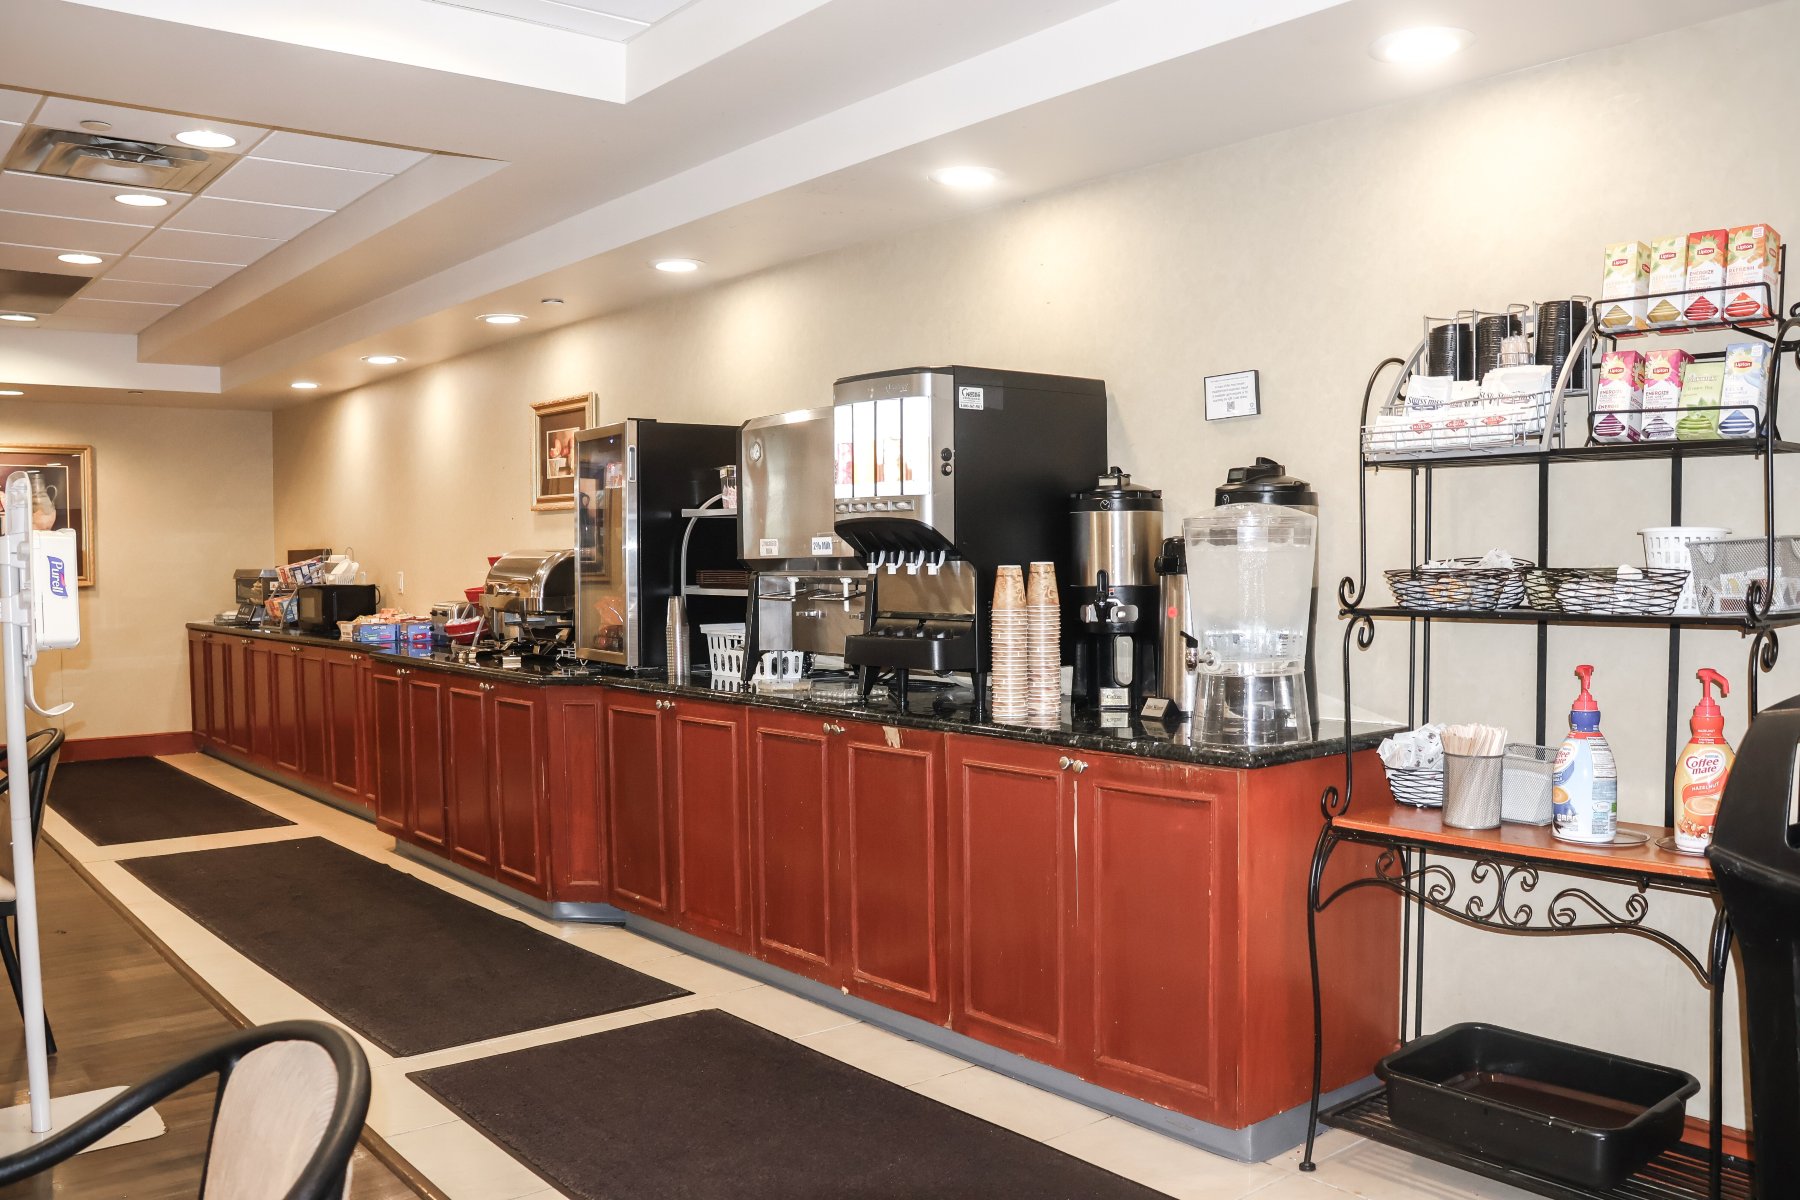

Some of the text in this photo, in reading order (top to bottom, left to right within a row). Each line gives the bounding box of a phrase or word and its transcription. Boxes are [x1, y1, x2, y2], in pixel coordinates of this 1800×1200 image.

[51, 560, 64, 593] Purell
[1686, 756, 1719, 769] Coffee
[1692, 765, 1717, 775] mate
[1691, 781, 1720, 792] HAZELNUT
